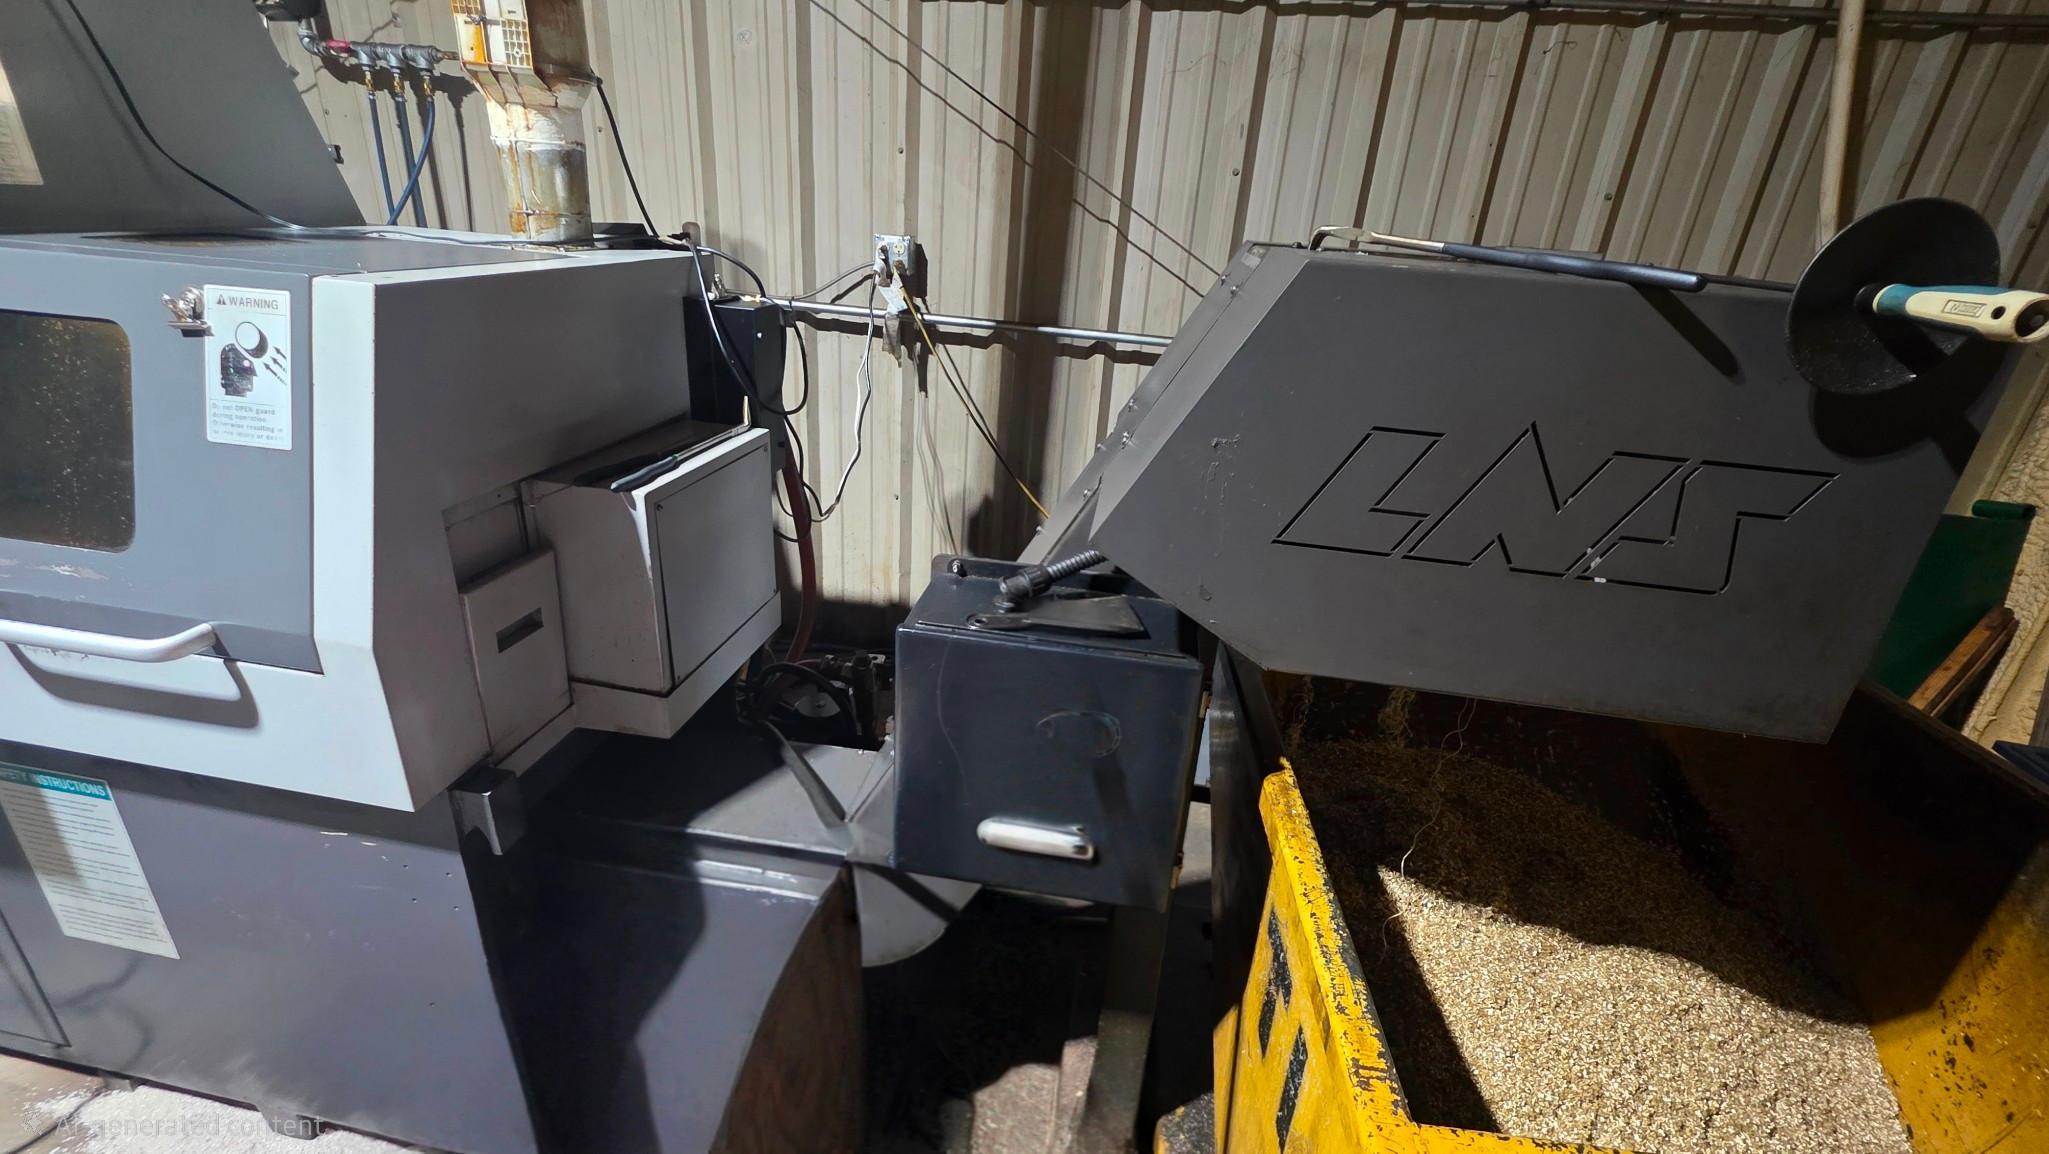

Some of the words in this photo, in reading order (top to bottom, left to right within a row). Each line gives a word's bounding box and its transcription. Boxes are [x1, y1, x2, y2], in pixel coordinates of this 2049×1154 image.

[228, 295, 279, 310] WARNING
[1271, 420, 1840, 595] LNS
[31, 772, 106, 797] INSTRUCTIONS
